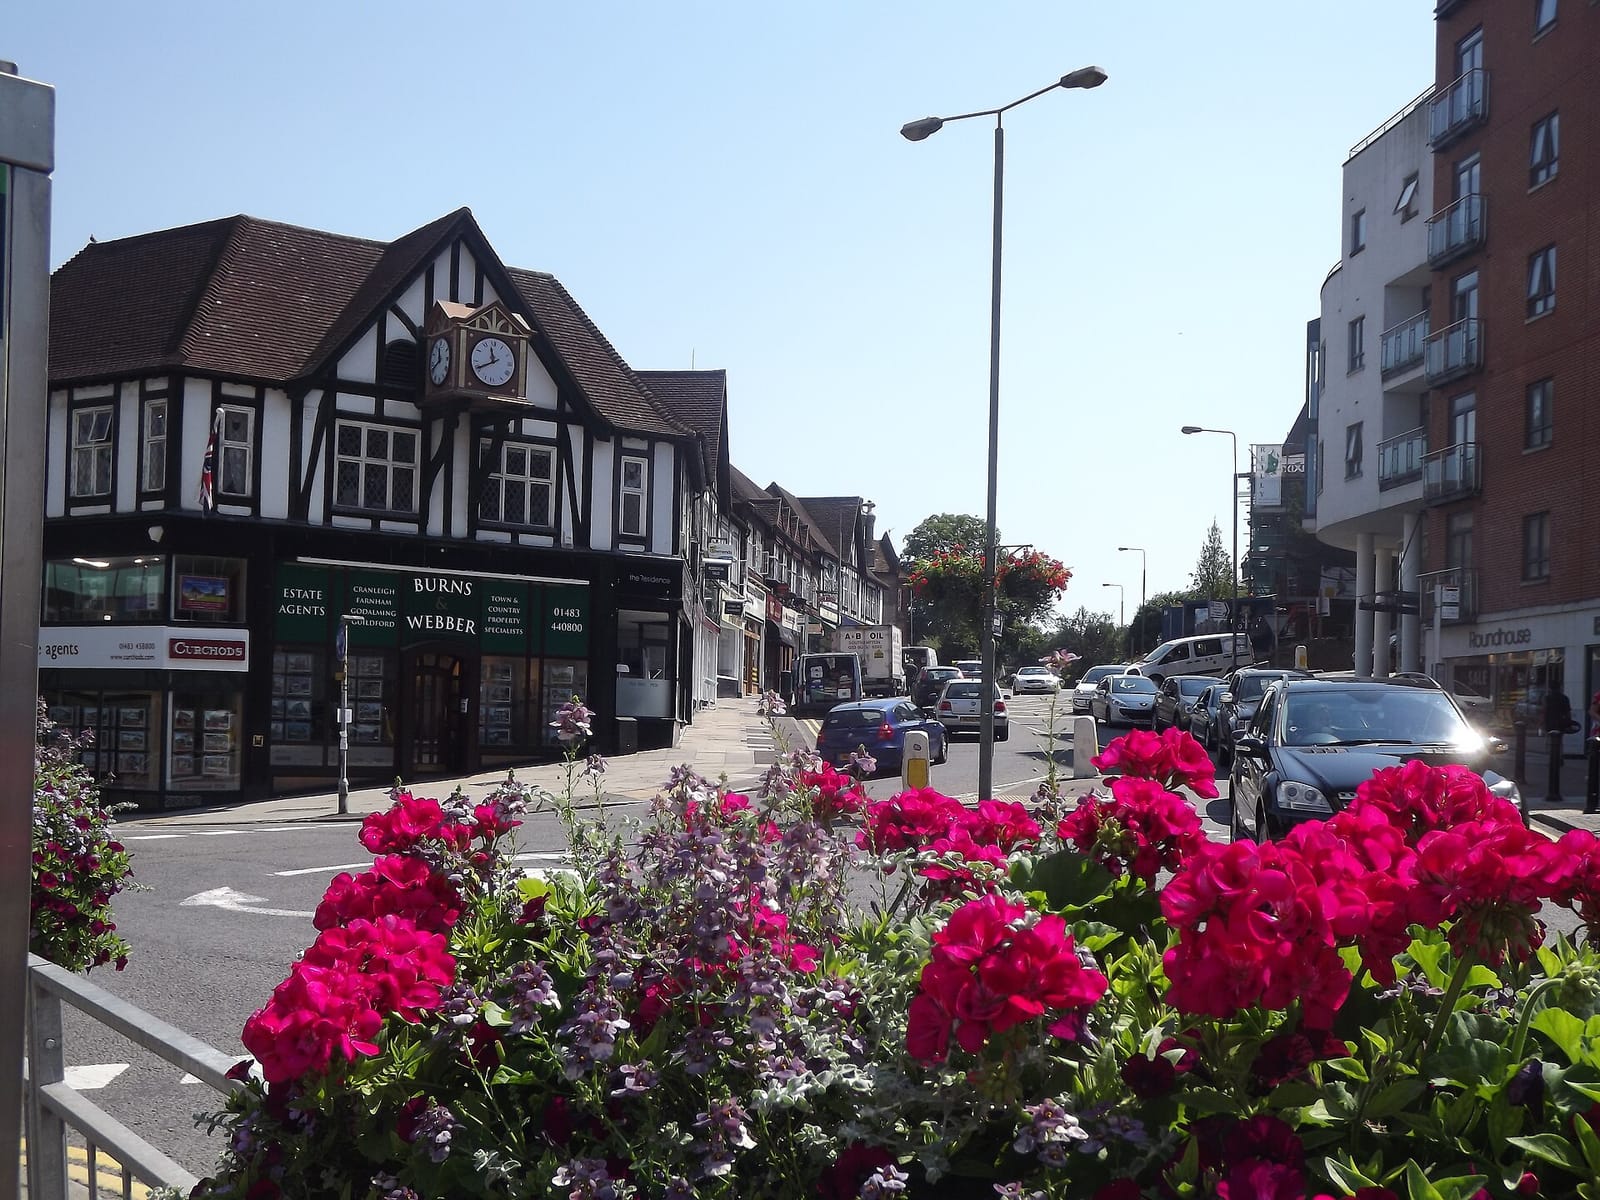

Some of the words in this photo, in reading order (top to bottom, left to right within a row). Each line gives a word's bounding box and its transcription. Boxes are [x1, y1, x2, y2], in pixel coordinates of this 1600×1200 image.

[353, 586, 395, 595] CRANLEIGH
[413, 578, 473, 596] BURNS
[283, 588, 323, 600] ESTATE
[491, 595, 512, 603] TOWN
[356, 597, 392, 606] FARNHAM
[278, 604, 325, 616] AGENTS
[350, 607, 397, 617] GODALMING
[487, 605, 521, 614] COUNTRY
[553, 607, 580, 617] 01483
[351, 618, 395, 628] GUILDFORD
[406, 615, 476, 635] WEBBER
[487, 616, 521, 624] PROPERTY
[484, 626, 524, 635] SPECIALISTS
[551, 622, 583, 632] 440800
[869, 632, 884, 640] OIL
[1469, 627, 1531, 649] Roundhouse
[45, 643, 79, 660] agents
[1468, 670, 1489, 686] SALE
